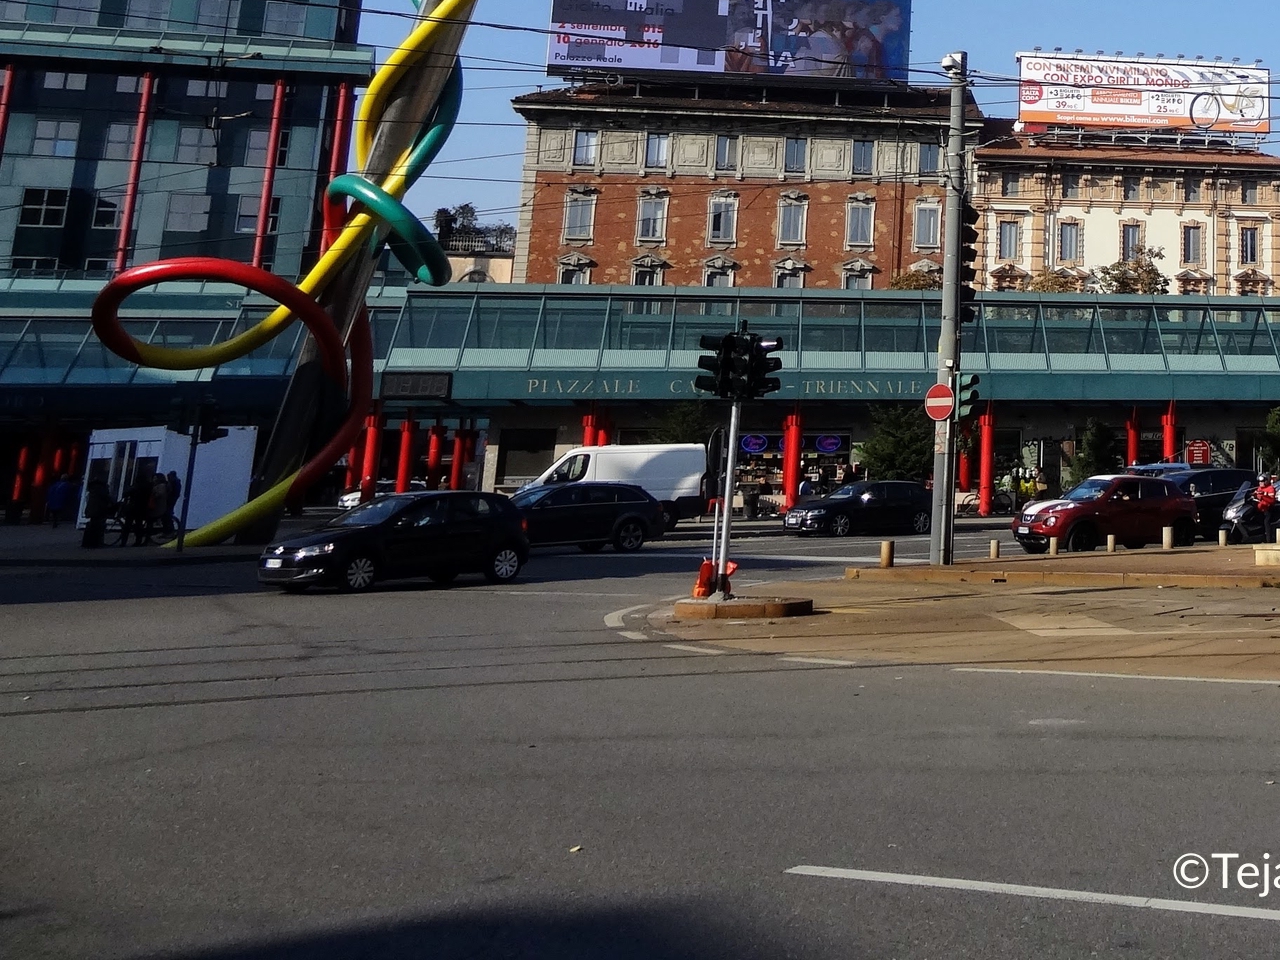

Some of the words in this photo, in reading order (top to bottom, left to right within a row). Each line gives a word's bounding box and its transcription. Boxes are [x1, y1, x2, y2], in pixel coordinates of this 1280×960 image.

[556, 34, 571, 44] 10
[555, 52, 593, 62] Palazzo
[596, 54, 623, 64] Reale
[1026, 61, 1052, 71] CON
[1055, 62, 1093, 74] BIKEMI
[1097, 64, 1120, 75] VIVI
[1043, 72, 1069, 83] CON
[1073, 74, 1103, 84] EXPO
[1107, 76, 1129, 85] GIRI
[1056, 113, 1075, 122] Scopri
[1101, 114, 1169, 125] www.bikemi.com
[527, 378, 641, 394] PIAZZALE
[802, 380, 923, 395] TRIENNALE
